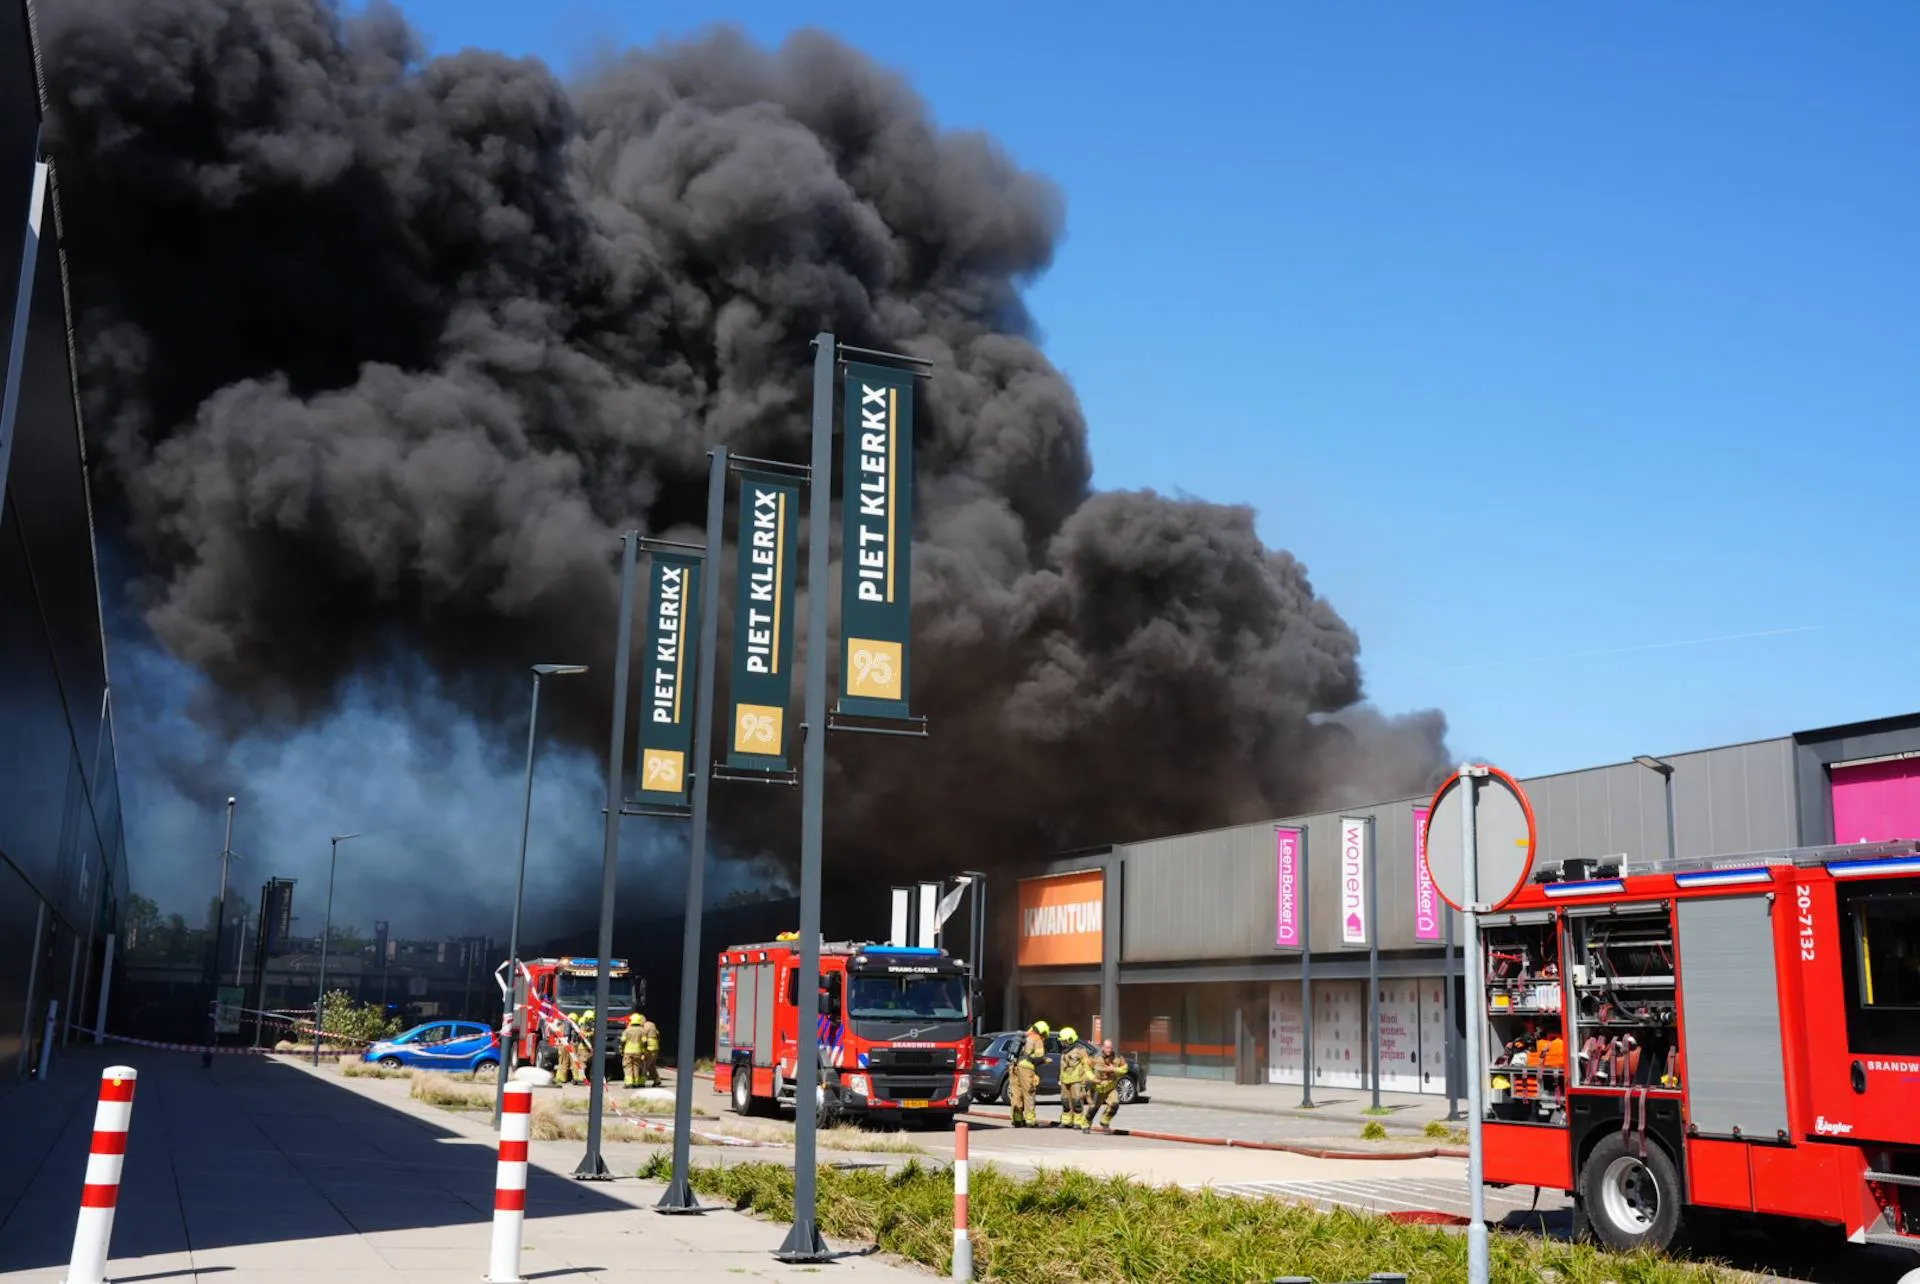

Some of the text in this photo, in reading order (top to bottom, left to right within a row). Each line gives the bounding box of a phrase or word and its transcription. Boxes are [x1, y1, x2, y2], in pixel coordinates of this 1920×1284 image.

[858, 383, 888, 602] PIET KLERKX
[746, 489, 777, 675] PIET KLERKX
[652, 566, 682, 724] PIET KLERKX
[852, 647, 896, 689] 95
[740, 713, 775, 744] 95
[647, 756, 677, 785] 95
[1282, 838, 1294, 925] LeenBakker
[1346, 827, 1360, 909] wonen
[1024, 901, 1102, 937] KWANTUM
[1796, 884, 1815, 961] 20-7132
[1379, 1013, 1398, 1024] Mooi
[1379, 1038, 1396, 1050] lage
